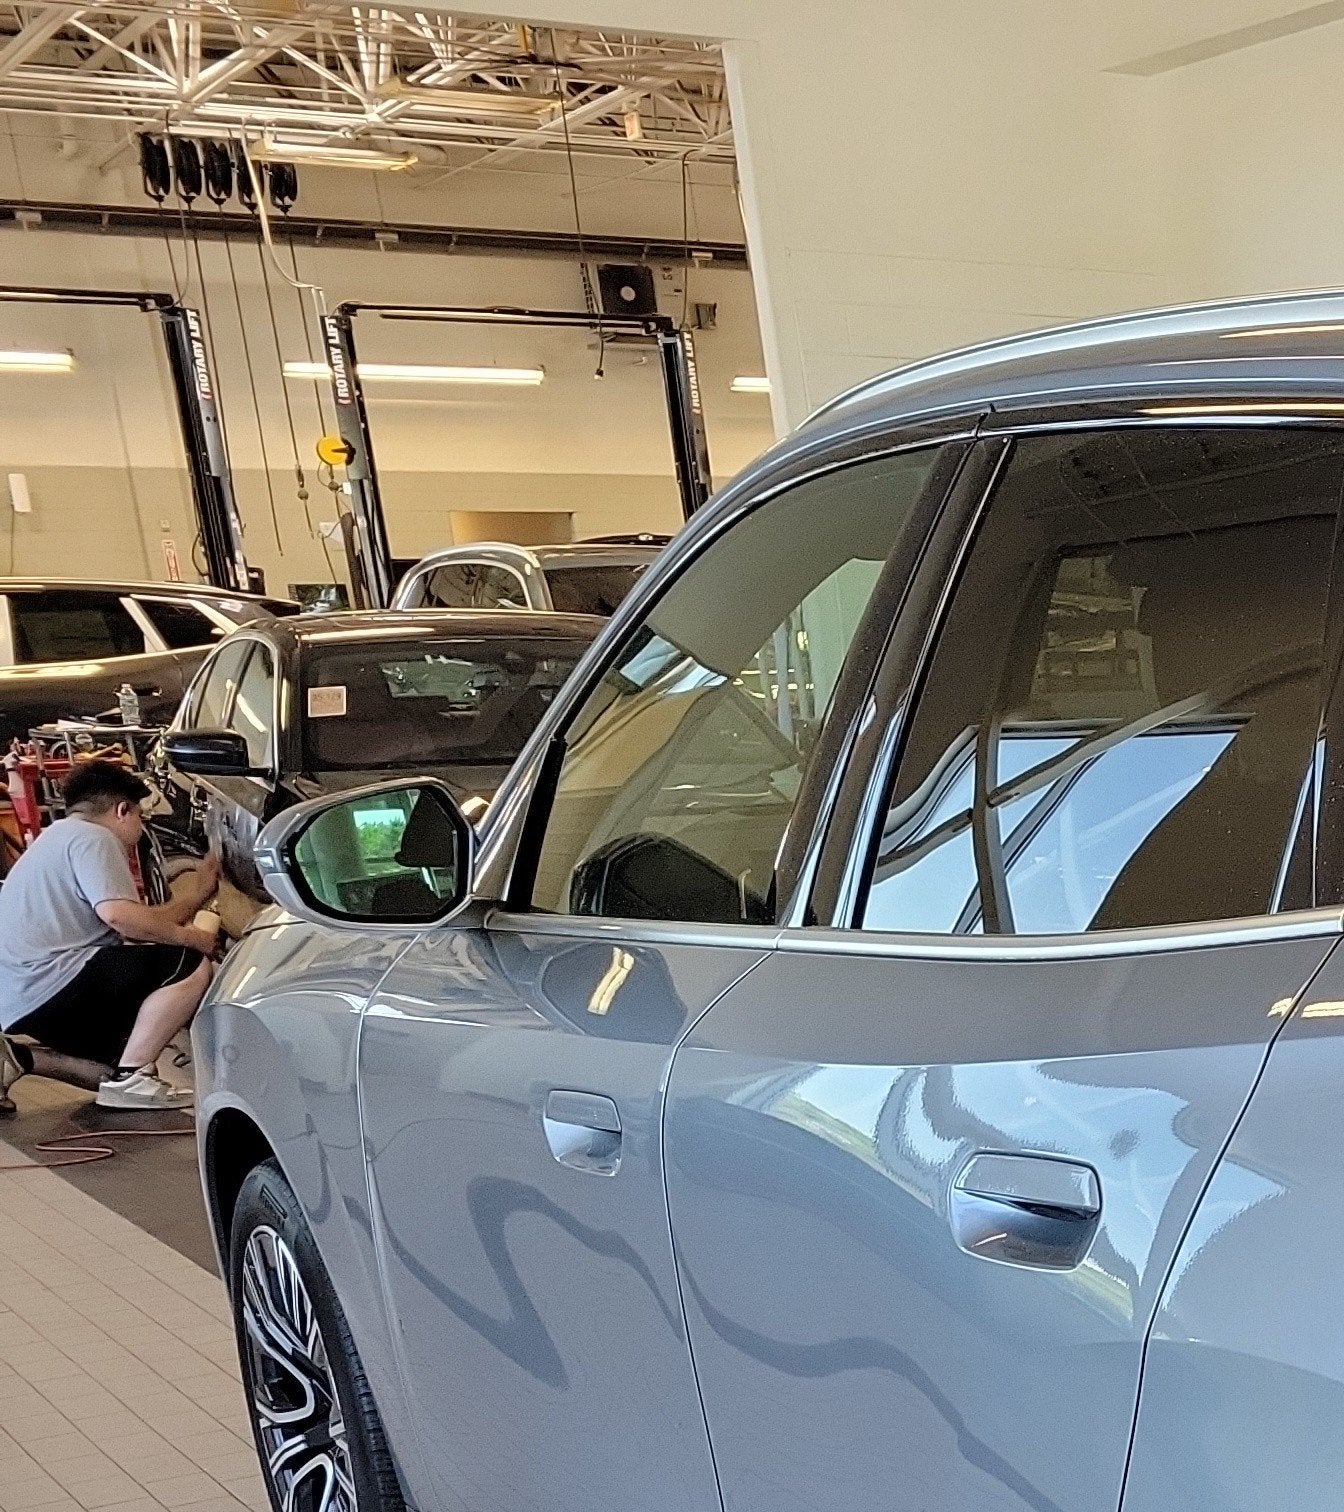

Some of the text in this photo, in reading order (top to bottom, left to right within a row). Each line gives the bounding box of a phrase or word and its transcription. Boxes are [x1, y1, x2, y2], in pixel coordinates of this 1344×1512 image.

[186, 308, 211, 393] ROTARY LIFT
[324, 316, 350, 398] ROTARY LIFT
[687, 360, 701, 408] ROTARY
